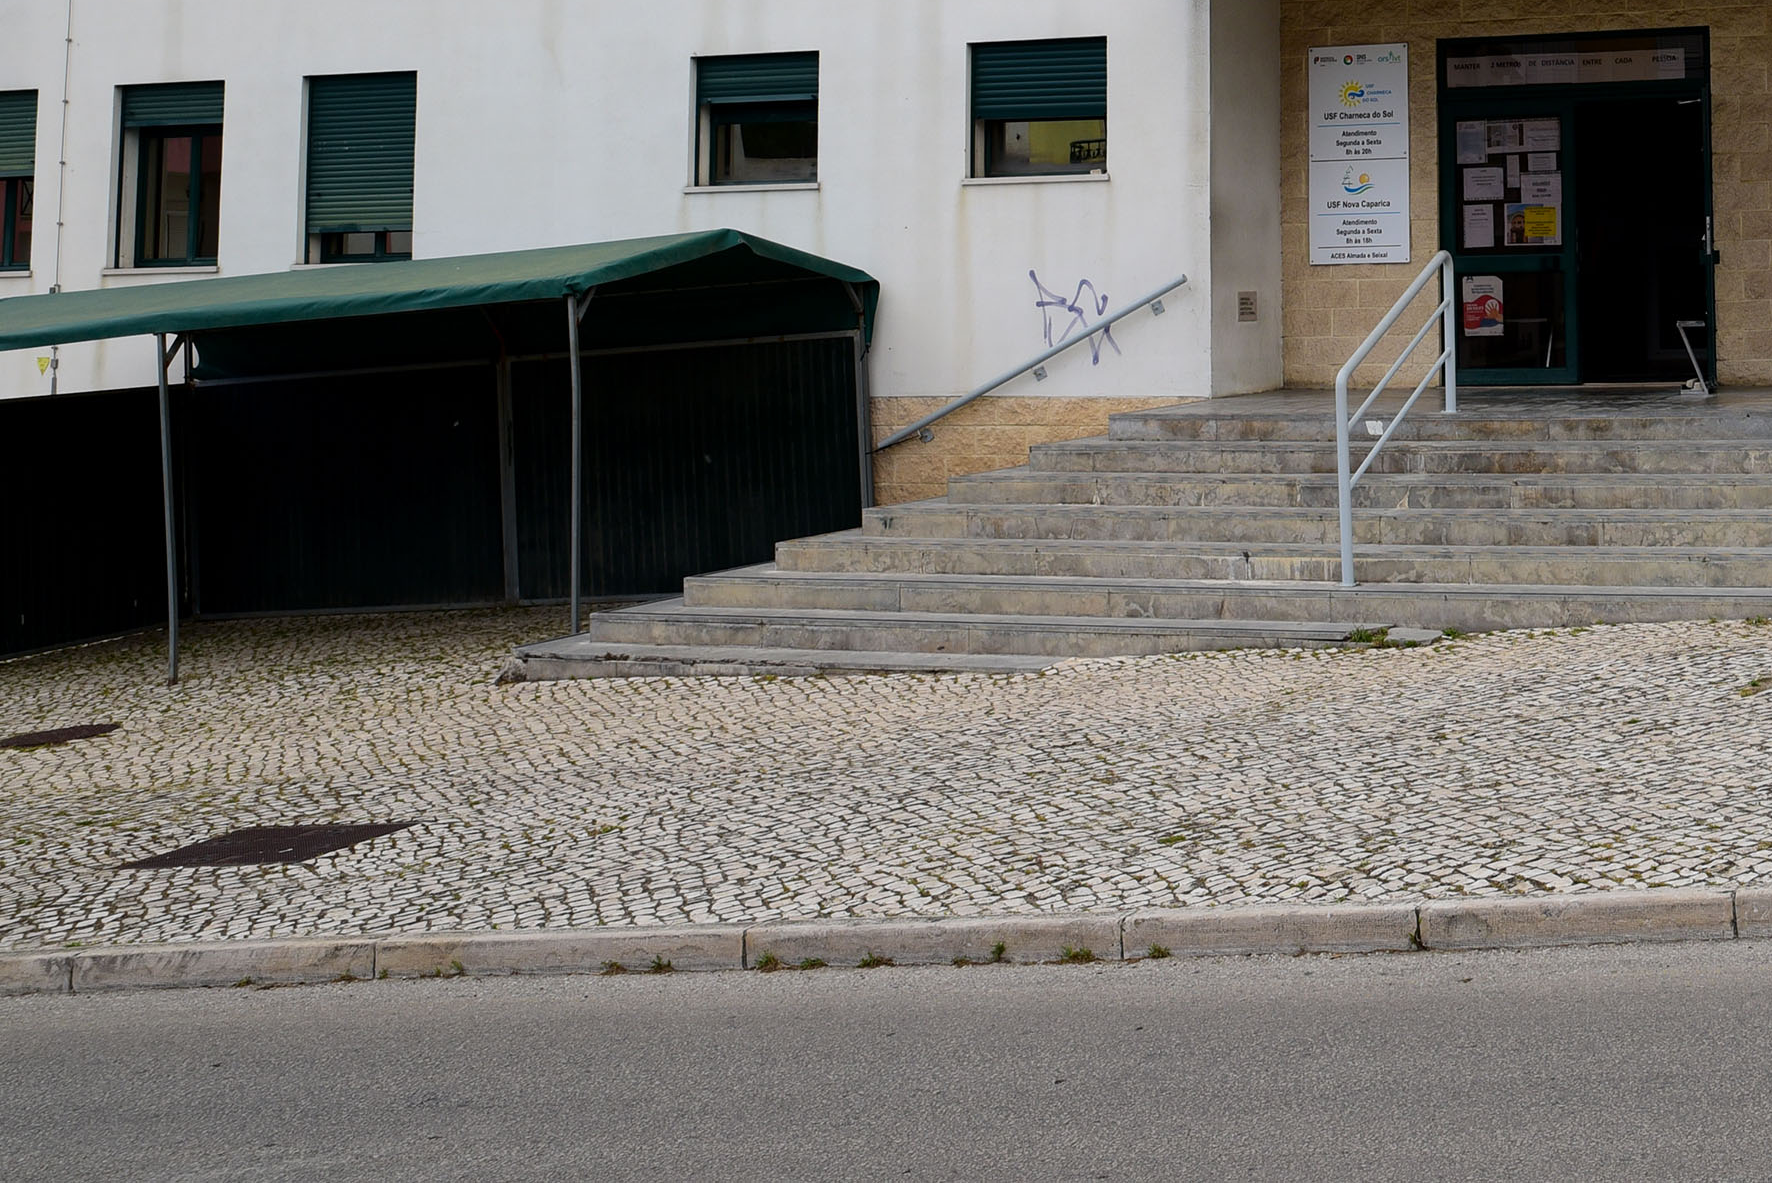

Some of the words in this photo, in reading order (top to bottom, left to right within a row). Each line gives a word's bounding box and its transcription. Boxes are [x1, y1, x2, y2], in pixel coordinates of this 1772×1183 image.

[1541, 58, 1575, 66] DISTÂNCIA
[1582, 58, 1602, 66] ENTRE
[1614, 57, 1633, 65] CADA
[1651, 55, 1676, 63] PESSOA
[1324, 112, 1338, 120] USF
[1339, 111, 1371, 120] Charneca
[1372, 111, 1381, 119] do
[1382, 110, 1394, 118] Sol
[1342, 129, 1377, 137] Atendimento
[1336, 139, 1360, 147] Segunda
[1327, 201, 1341, 209] USF
[1361, 200, 1391, 210] Caparica
[1336, 228, 1360, 236] Segunda
